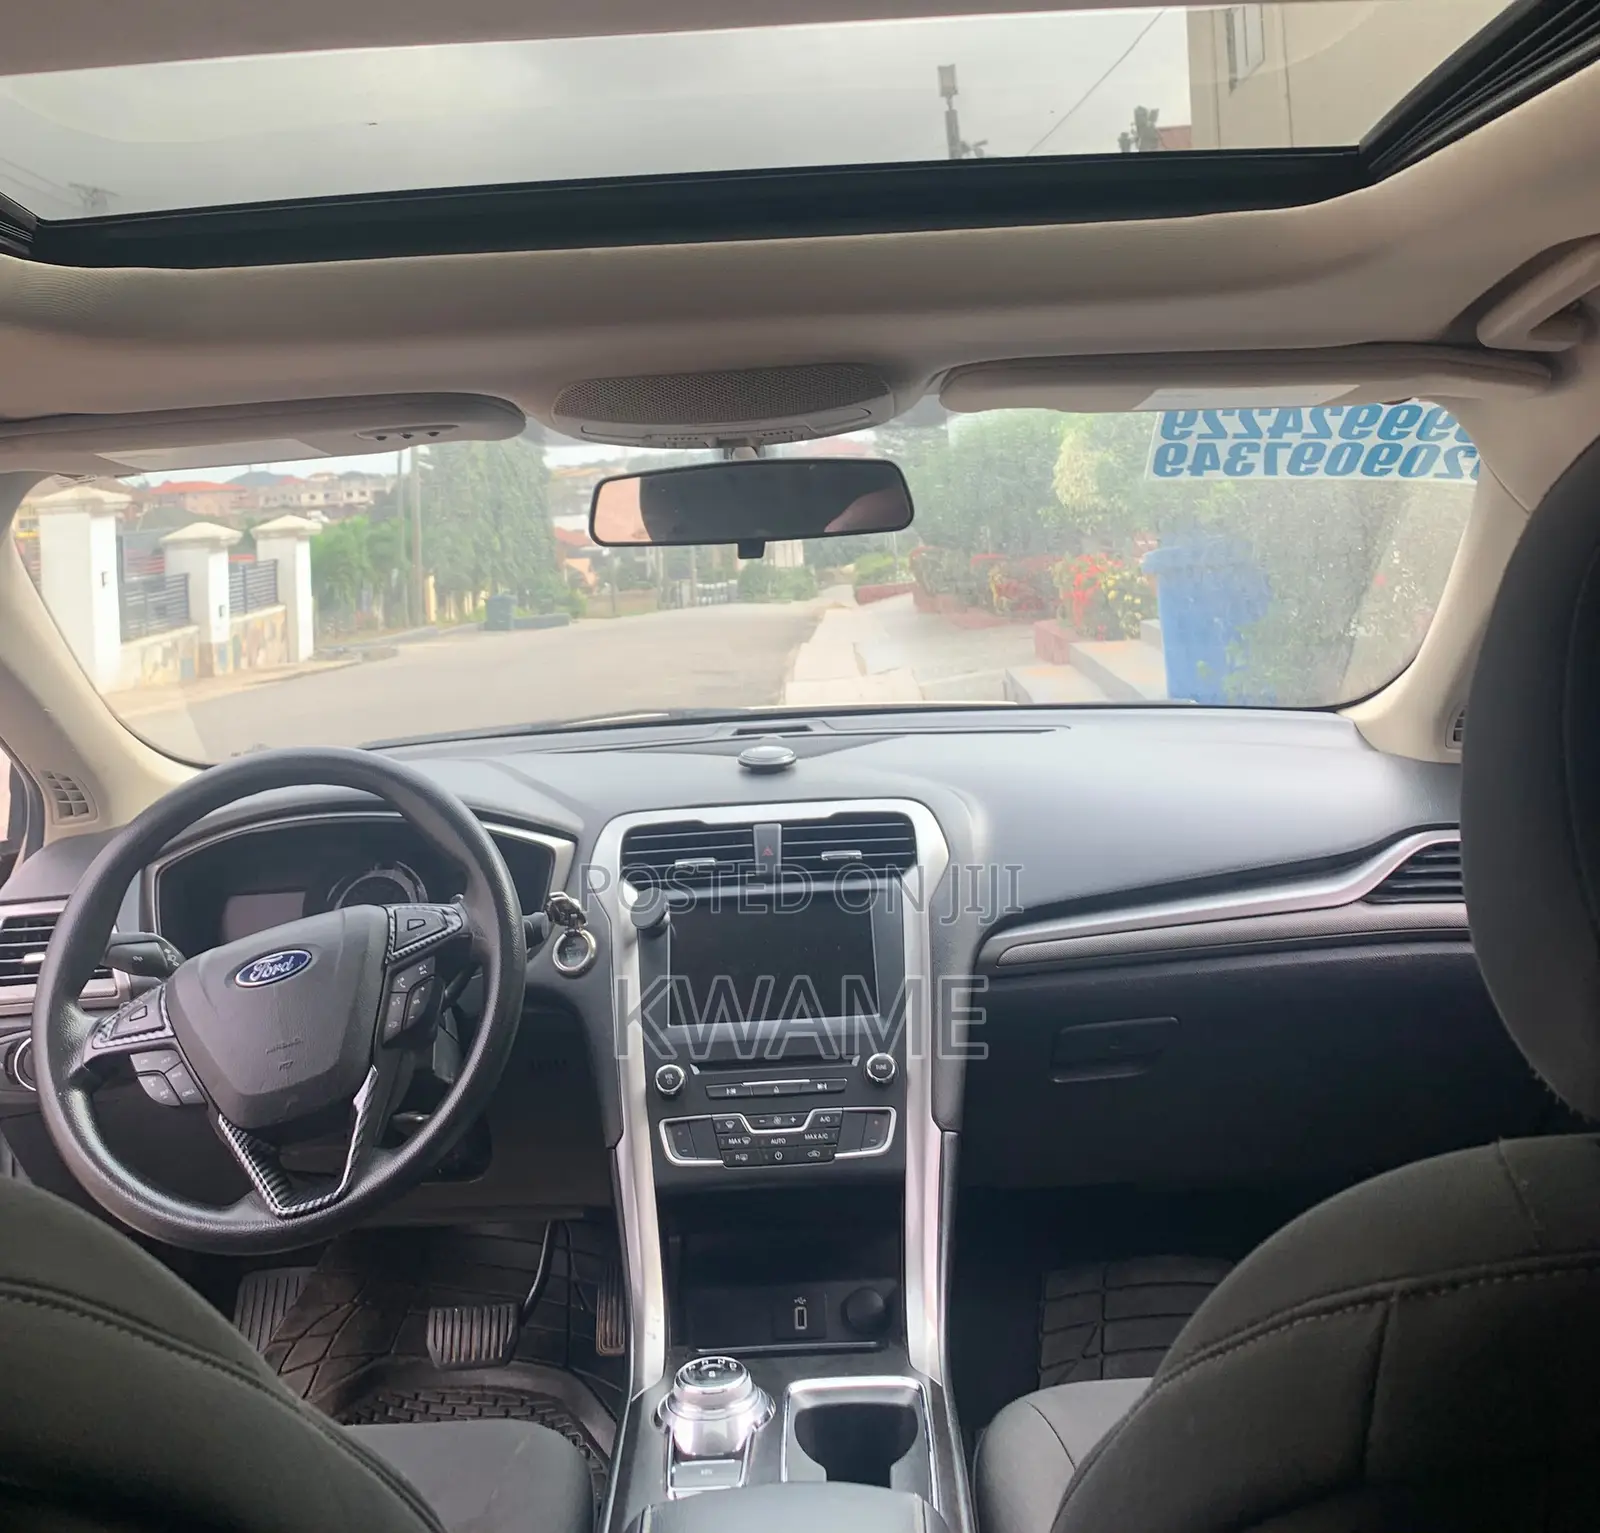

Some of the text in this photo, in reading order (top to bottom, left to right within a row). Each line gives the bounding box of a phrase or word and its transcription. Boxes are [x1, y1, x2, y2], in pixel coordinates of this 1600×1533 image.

[249, 954, 296, 982] Ford
[770, 1137, 787, 1145] AUTO
[804, 1132, 829, 1141] MAX A/C
